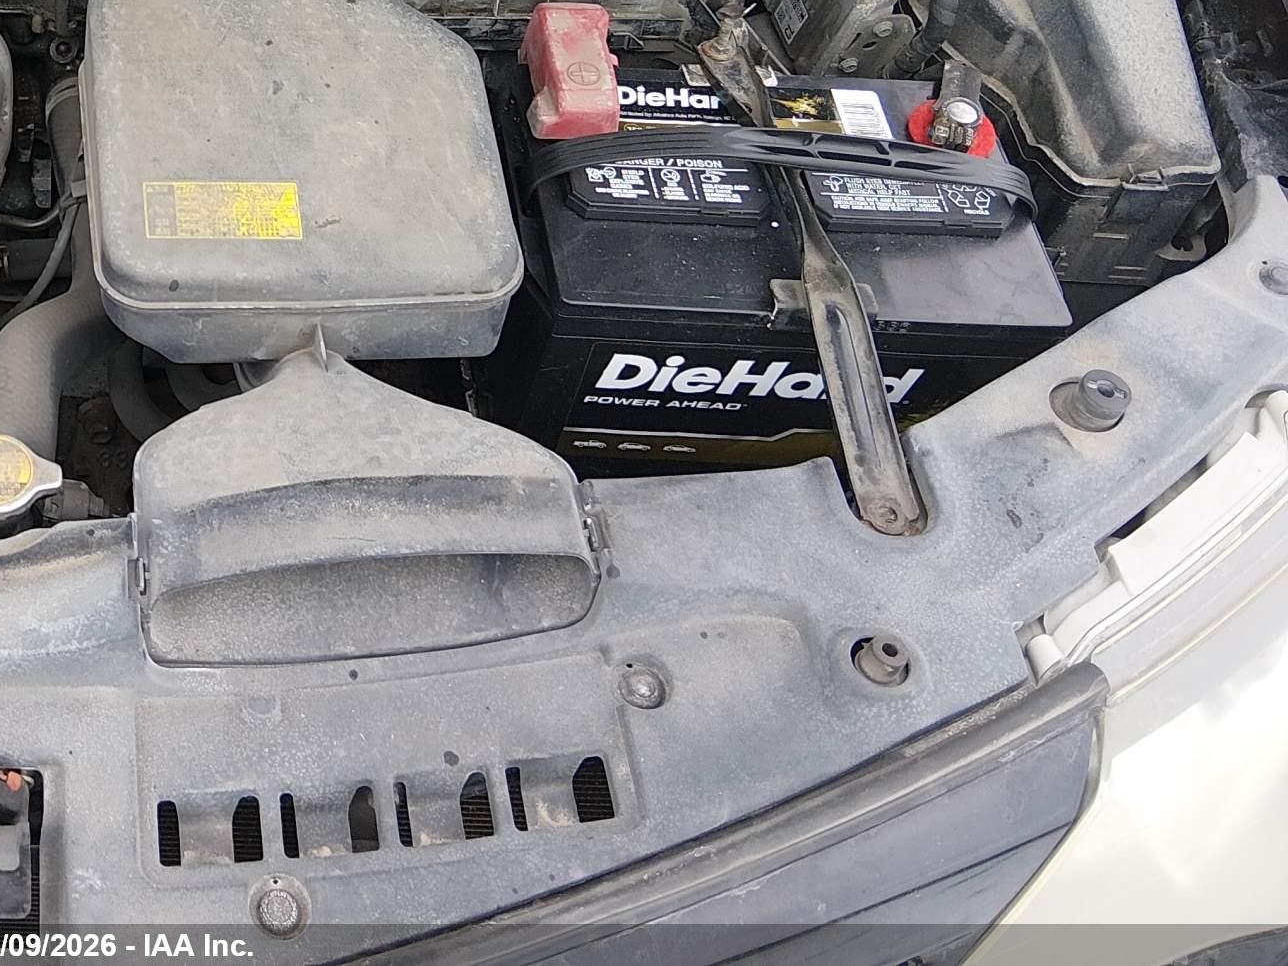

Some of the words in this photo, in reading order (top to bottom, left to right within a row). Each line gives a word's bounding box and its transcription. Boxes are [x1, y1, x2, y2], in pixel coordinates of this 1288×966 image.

[618, 84, 721, 110] DieHar
[615, 158, 663, 167] ANGER
[677, 158, 723, 168] POISON
[595, 353, 925, 404] DieHad
[583, 395, 659, 408] POWER
[664, 400, 742, 411] AHEAD
